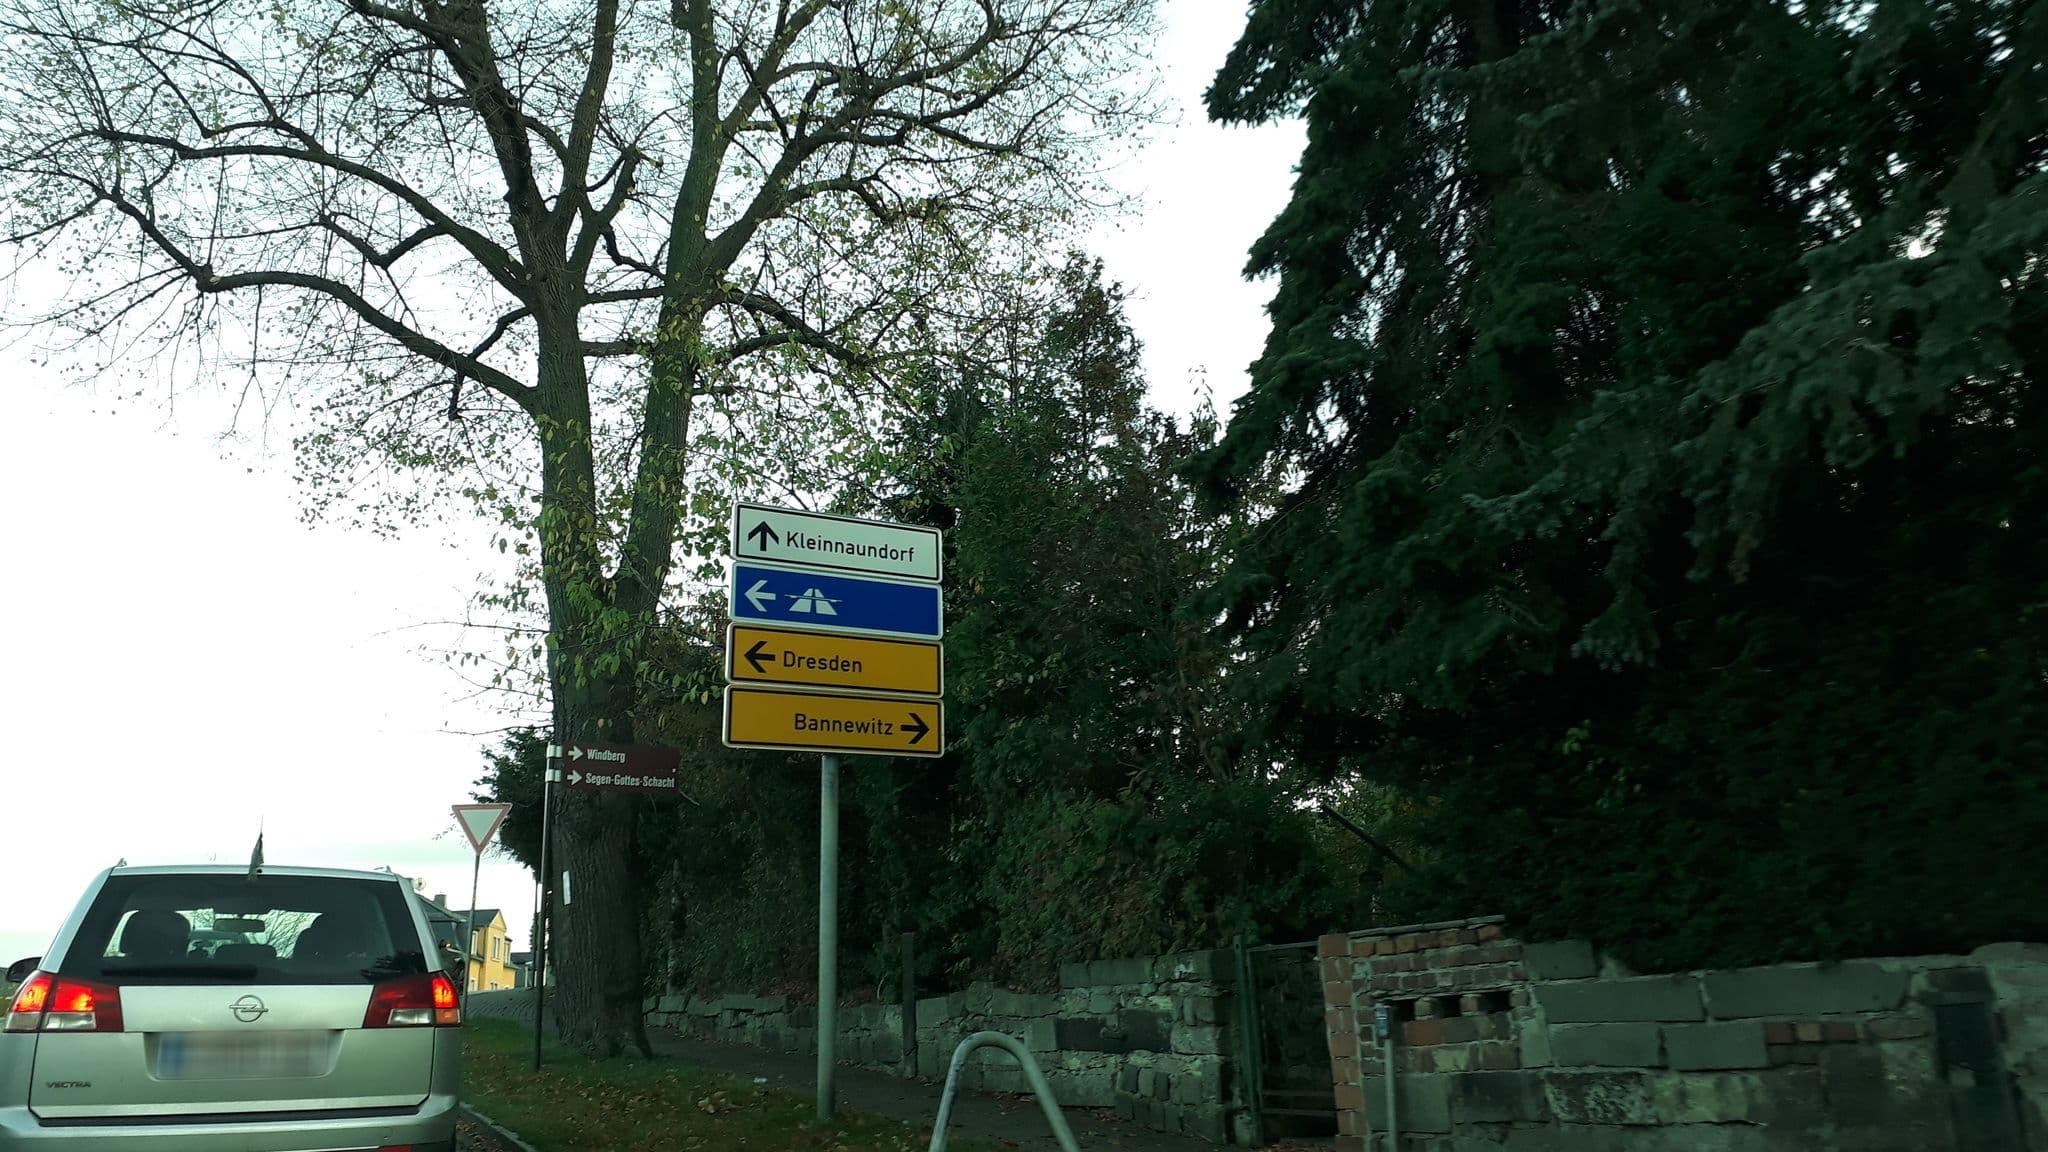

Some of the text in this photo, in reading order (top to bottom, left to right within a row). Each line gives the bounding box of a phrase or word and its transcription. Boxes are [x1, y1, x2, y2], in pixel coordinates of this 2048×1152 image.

[786, 531, 915, 562] Kleinnaundorf
[783, 650, 862, 673] Dresden
[794, 714, 893, 736] Bannewitz
[587, 749, 626, 763] Windberg
[585, 772, 675, 789] Segen-Gottes-Schacht
[45, 1081, 91, 1089] VECTRA
